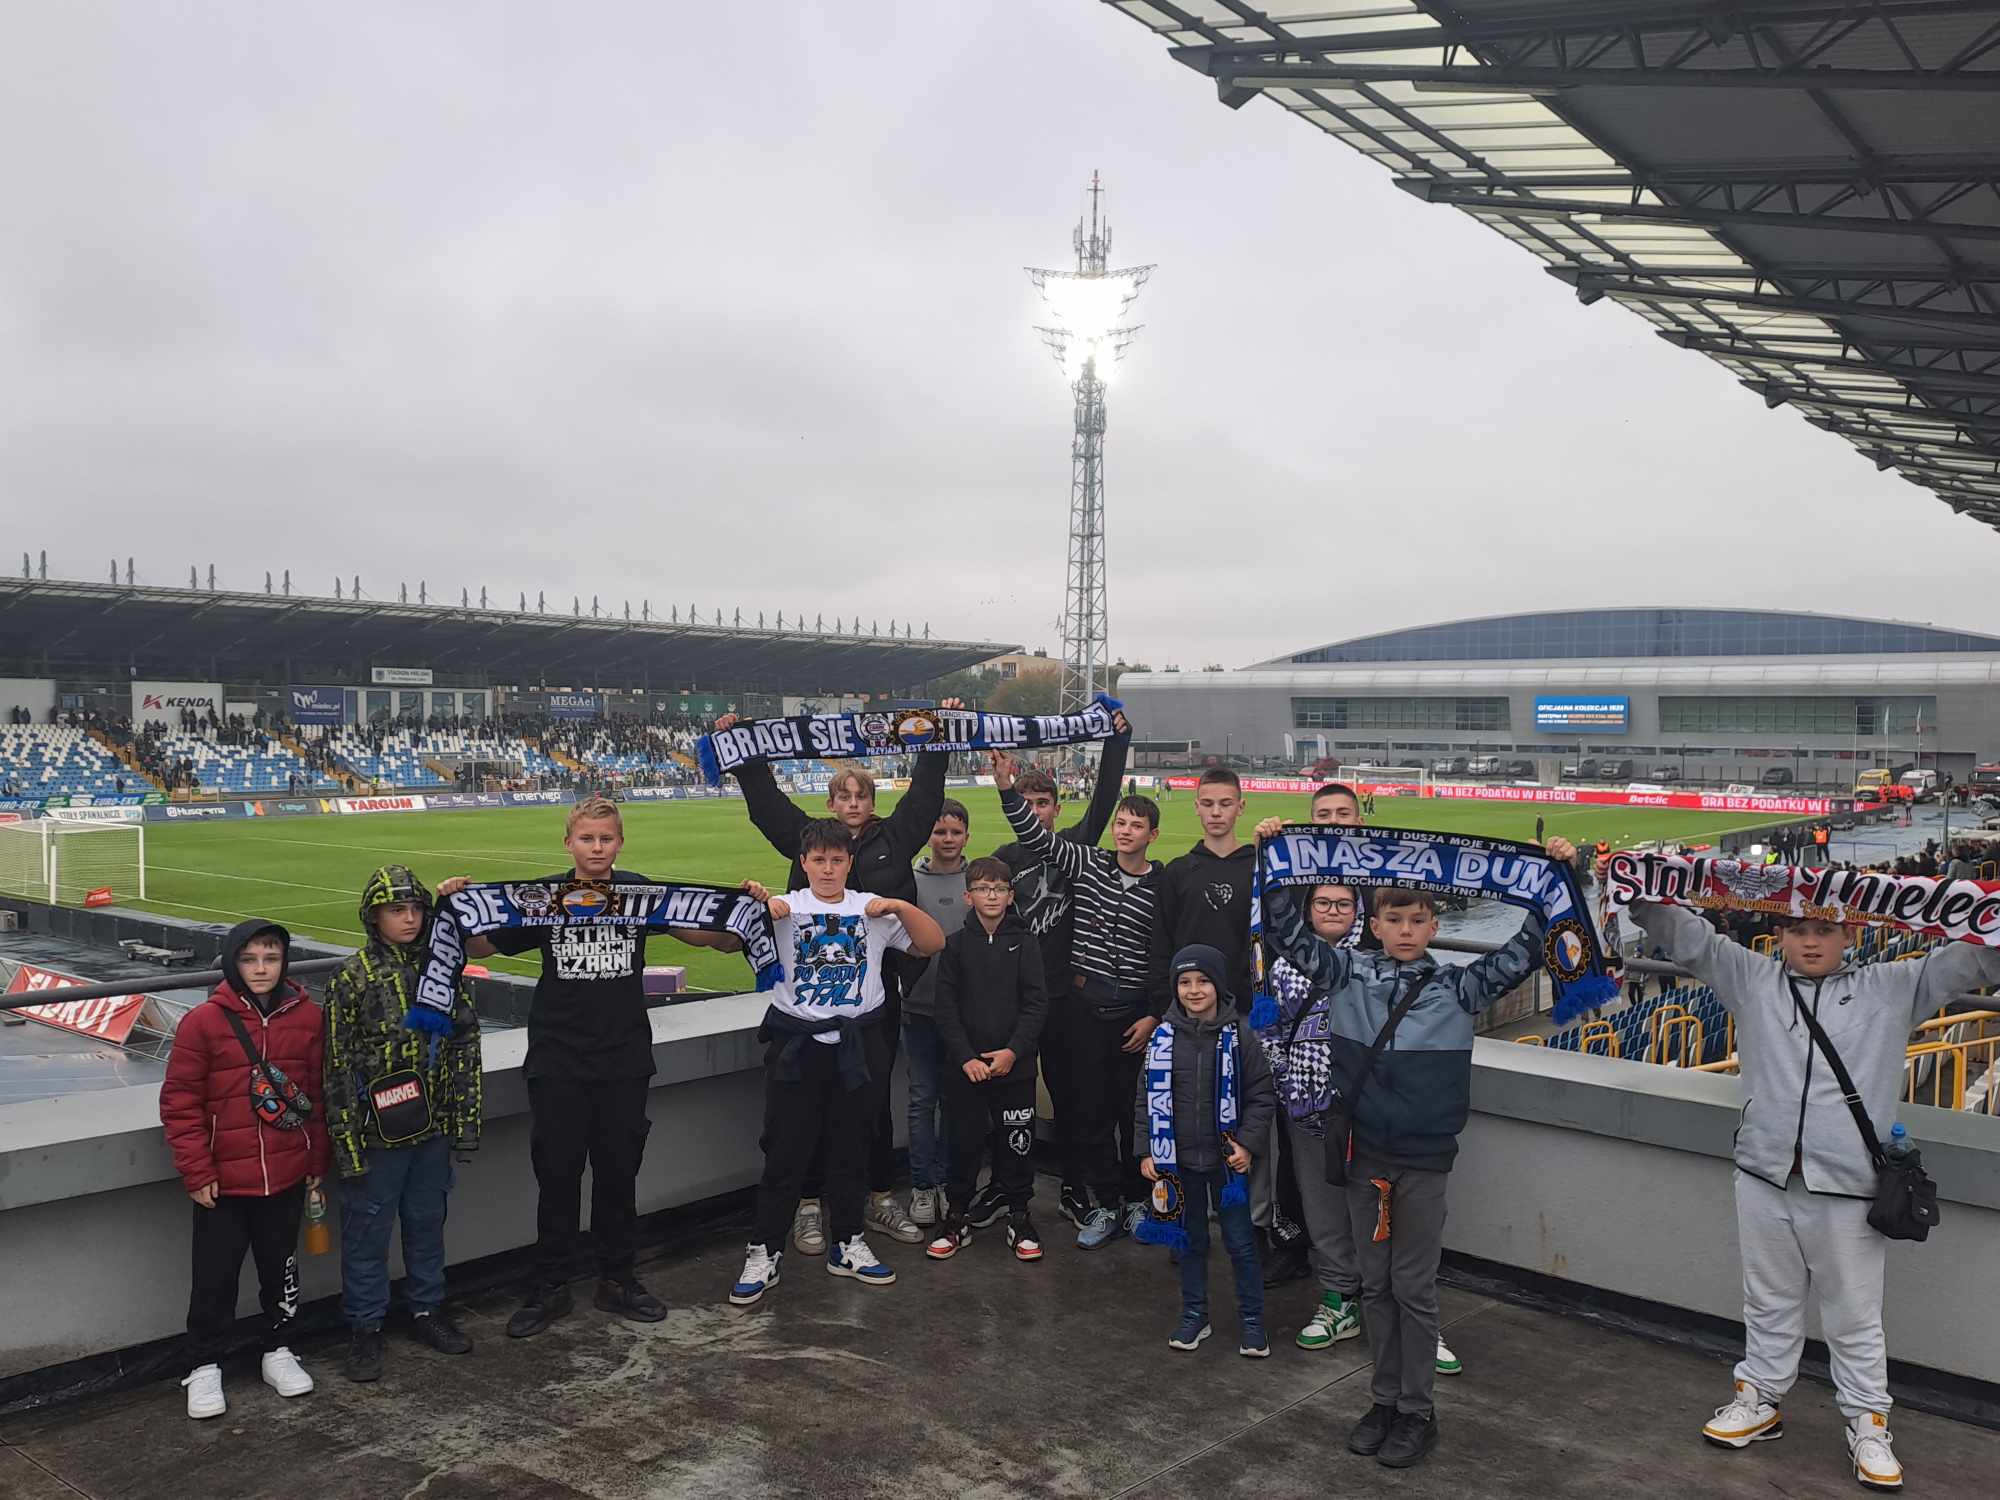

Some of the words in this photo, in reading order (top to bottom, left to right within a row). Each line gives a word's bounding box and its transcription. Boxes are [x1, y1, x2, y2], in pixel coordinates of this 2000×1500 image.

[166, 697, 213, 707] KENDA
[1574, 704, 1608, 712] KOLEKCJA
[939, 710, 977, 720] SANDECJA
[715, 720, 803, 766] BRACI
[983, 715, 1028, 743] NIE
[905, 743, 921, 753] JEST
[924, 742, 970, 753] WSZYSTKIM
[1250, 779, 1288, 790] PODATKU
[1289, 780, 1299, 790] W
[1455, 787, 1473, 799] BEZ
[1474, 788, 1520, 800] PODATKU
[1521, 789, 1534, 800] W
[1535, 790, 1576, 802] BETCLIC
[1628, 794, 1668, 805] Betclic
[347, 797, 413, 810] TARGUM
[1701, 796, 1723, 809] GRA
[1725, 796, 1749, 810] BEZ
[1751, 797, 1805, 811] PODATKU
[1807, 798, 1822, 812] W
[1281, 826, 1319, 835] SERCE
[1324, 827, 1357, 836] MOJE
[1362, 828, 1389, 838] TWE
[1394, 830, 1398, 839] I
[1402, 831, 1444, 844] DUSZA
[1449, 837, 1484, 849] MOJE
[1489, 841, 1517, 853] TWA
[1299, 838, 1444, 880] NASZA
[1610, 852, 1712, 906] Stal
[616, 885, 665, 895] SANDECJA
[1296, 876, 1339, 885] BARDZO
[1343, 876, 1393, 887] KOCHAM
[1396, 878, 1417, 890] CIĘ
[1420, 881, 1478, 898] DRUŻYNO
[1481, 890, 1503, 900] MA!
[568, 915, 589, 925] JEST
[592, 915, 648, 926] WSZYSTKIM
[563, 925, 623, 944] STAL
[422, 910, 464, 1008] BRACI
[664, 891, 727, 923] NIE
[726, 894, 777, 971] TRACI
[551, 939, 636, 957] SANDECJA
[556, 952, 632, 973] CZARNI
[793, 983, 863, 1007] STAL
[374, 1080, 420, 1109] MARVEL
[1003, 1107, 1035, 1121] NASA
[1152, 1072, 1173, 1159] STAL
